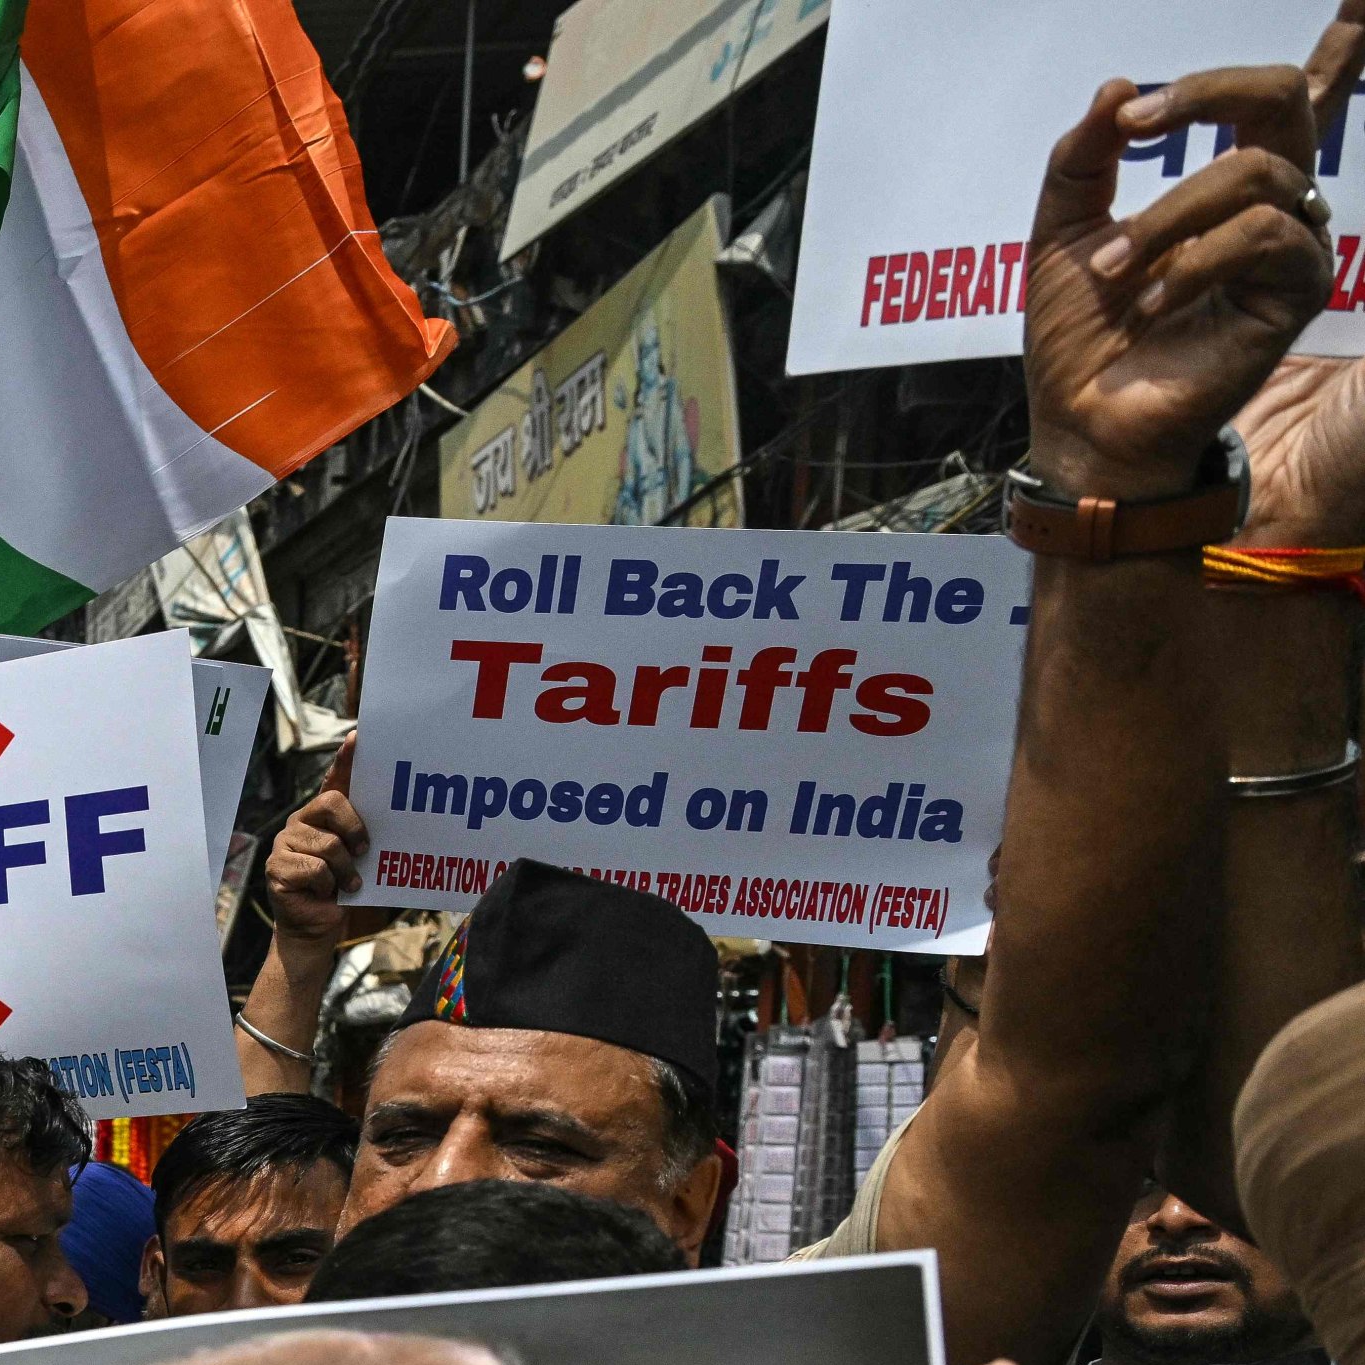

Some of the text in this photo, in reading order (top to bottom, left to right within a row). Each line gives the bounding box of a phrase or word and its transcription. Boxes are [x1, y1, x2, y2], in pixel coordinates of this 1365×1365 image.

[439, 554, 985, 626] Roll Back The
[450, 639, 934, 738] Tariffs
[390, 761, 964, 844] Imposed on India
[376, 850, 490, 896] FEDERATION
[731, 876, 870, 925] ASSOCIATION
[869, 882, 949, 940] (FESTA)
[114, 1042, 196, 1103] (FESTA)
